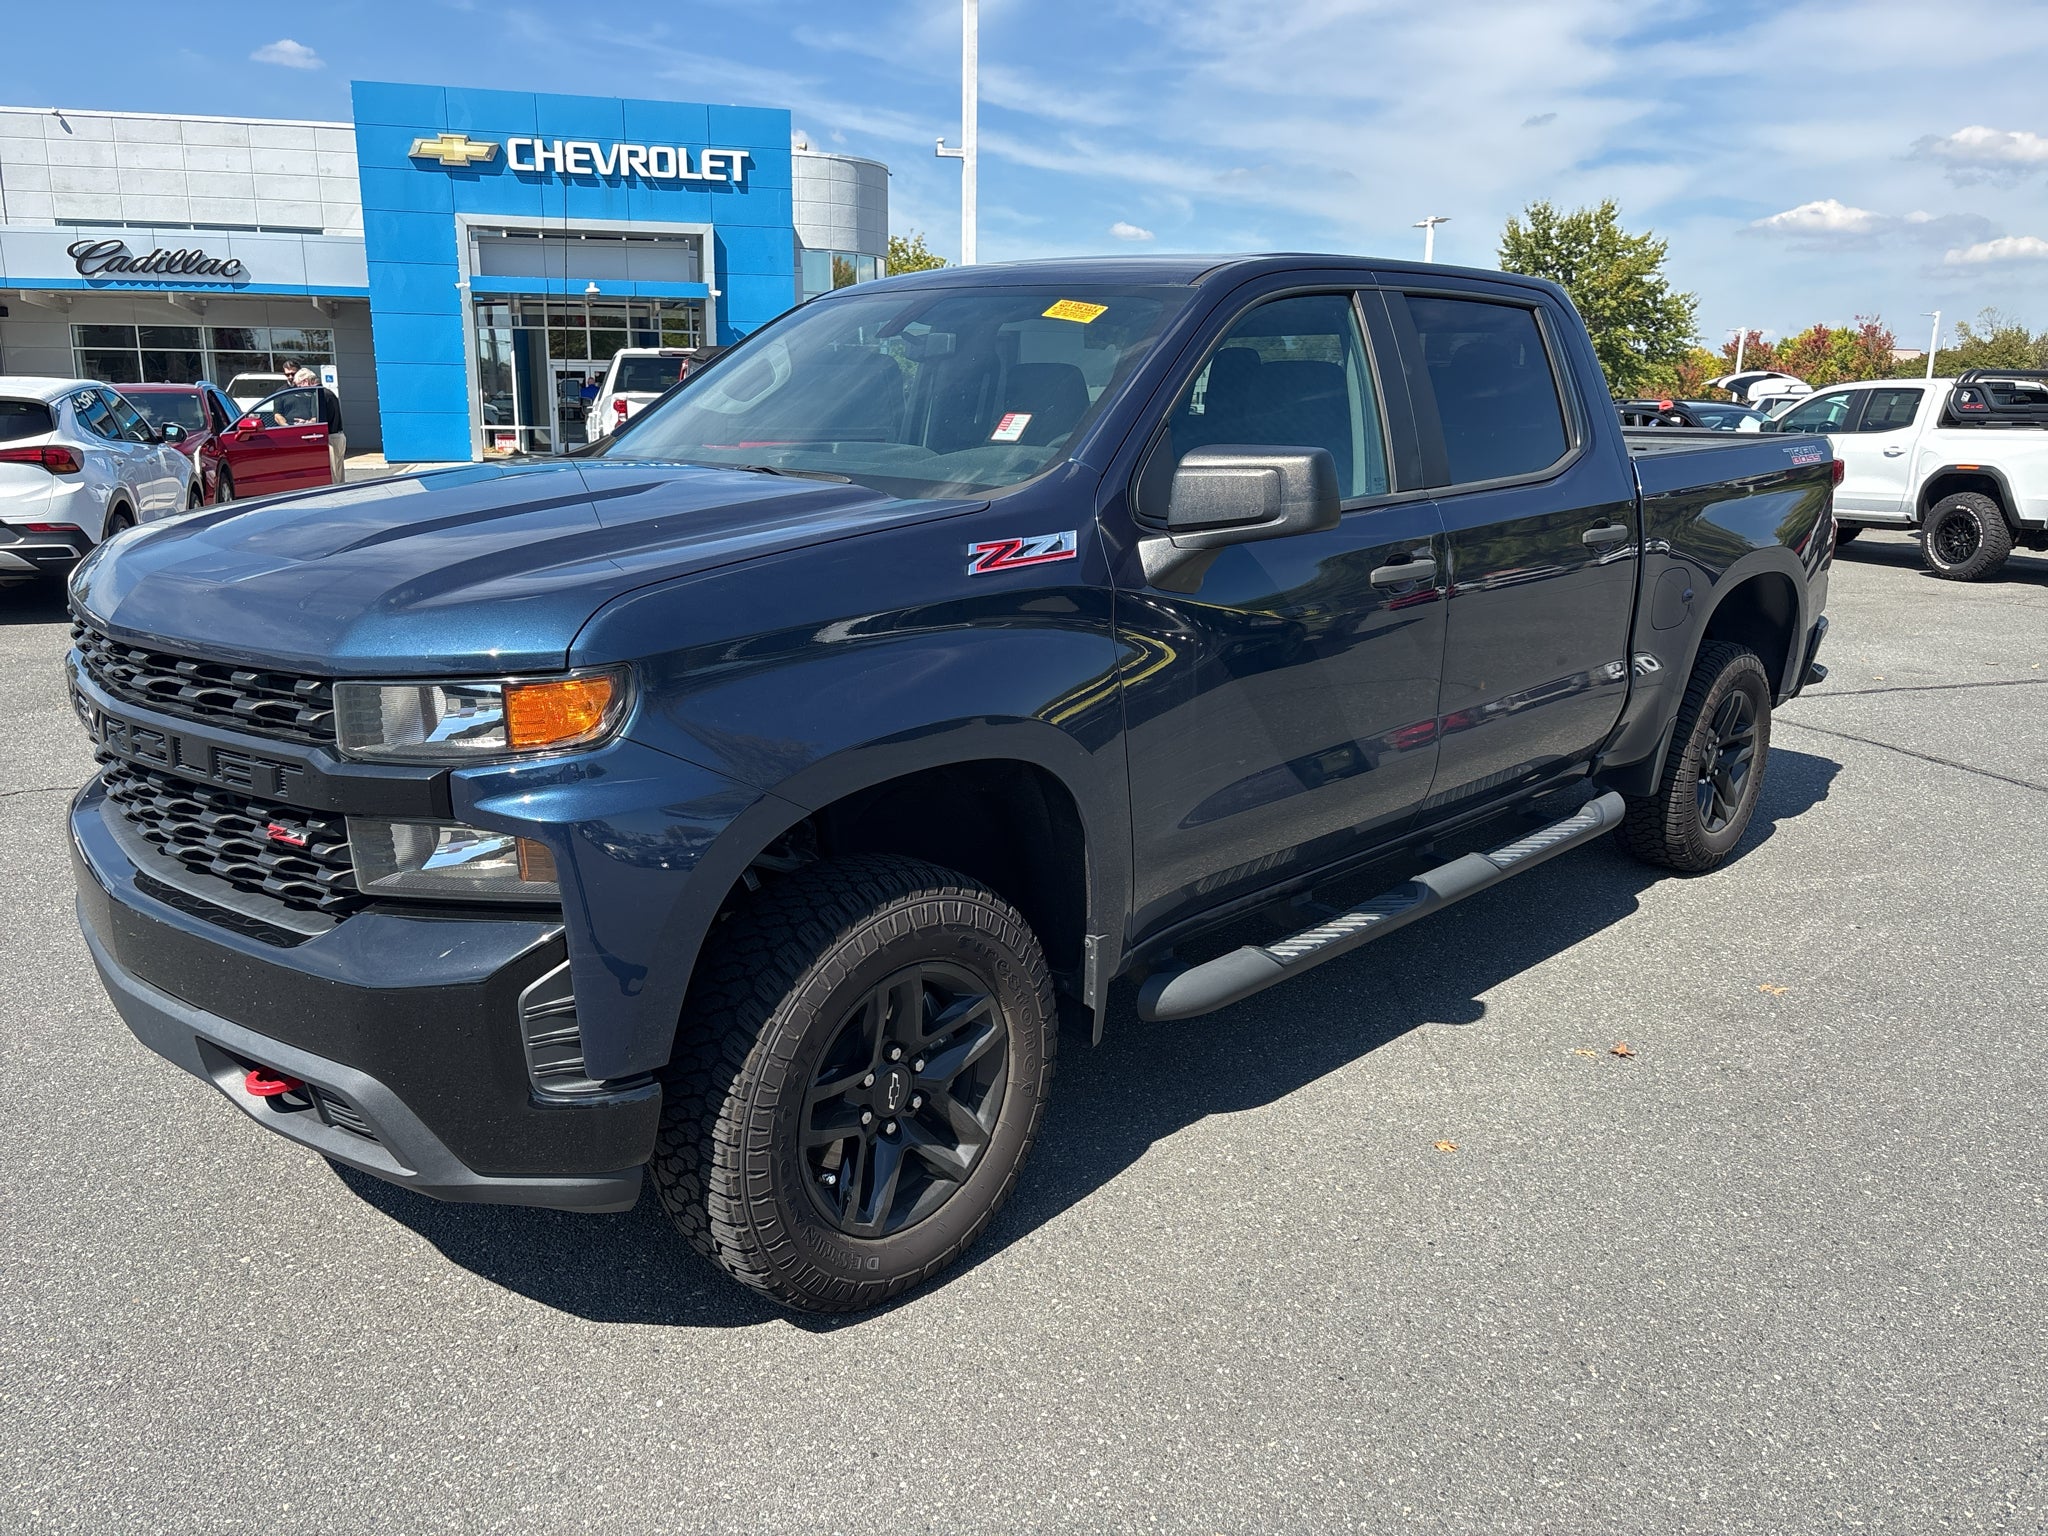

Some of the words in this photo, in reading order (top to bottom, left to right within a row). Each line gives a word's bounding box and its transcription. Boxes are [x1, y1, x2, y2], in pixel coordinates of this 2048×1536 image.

[507, 137, 750, 181] CHEVROLET
[67, 239, 241, 278] Cadillac
[1782, 444, 1823, 457] TRAIL
[1792, 454, 1822, 465] BOSS
[967, 529, 1077, 576] Z71
[266, 822, 312, 847] Z71
